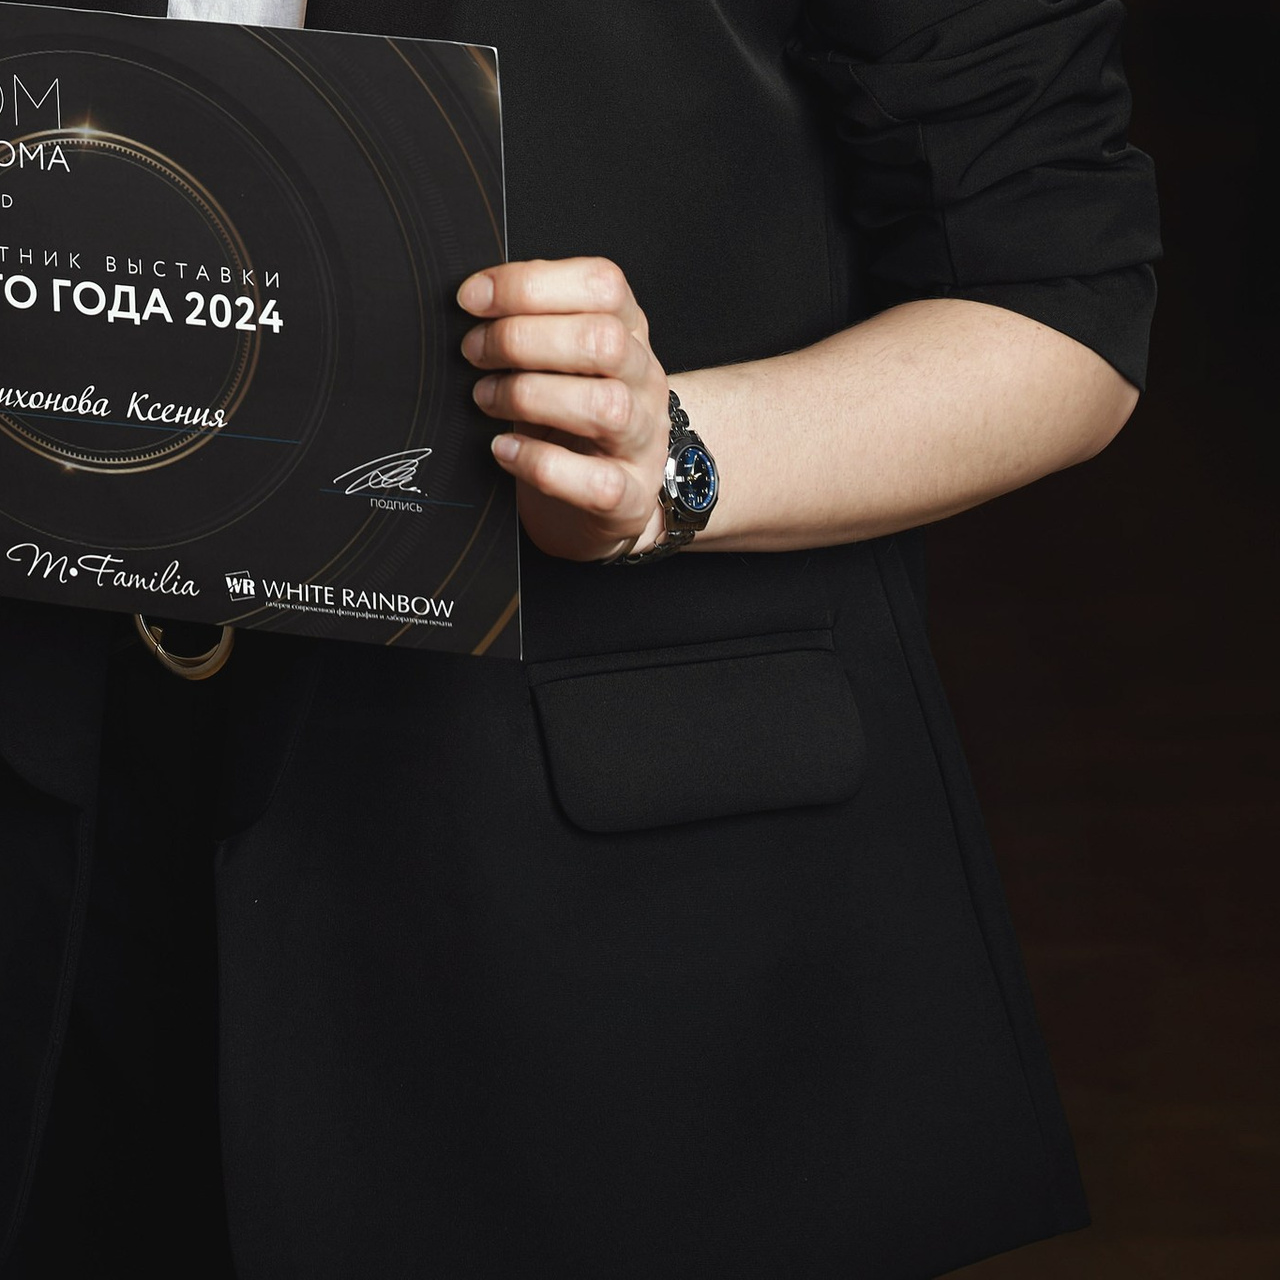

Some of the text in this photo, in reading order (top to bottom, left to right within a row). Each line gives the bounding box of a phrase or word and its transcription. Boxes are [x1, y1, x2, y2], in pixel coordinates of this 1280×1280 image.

[105, 255, 281, 289] ВЫСТАВКИ
[52, 278, 174, 326] ГОДА
[184, 291, 284, 334] 2024
[126, 391, 228, 429] Ксения
[225, 576, 256, 596] WR
[262, 579, 455, 618] WHITE RAINBOW
